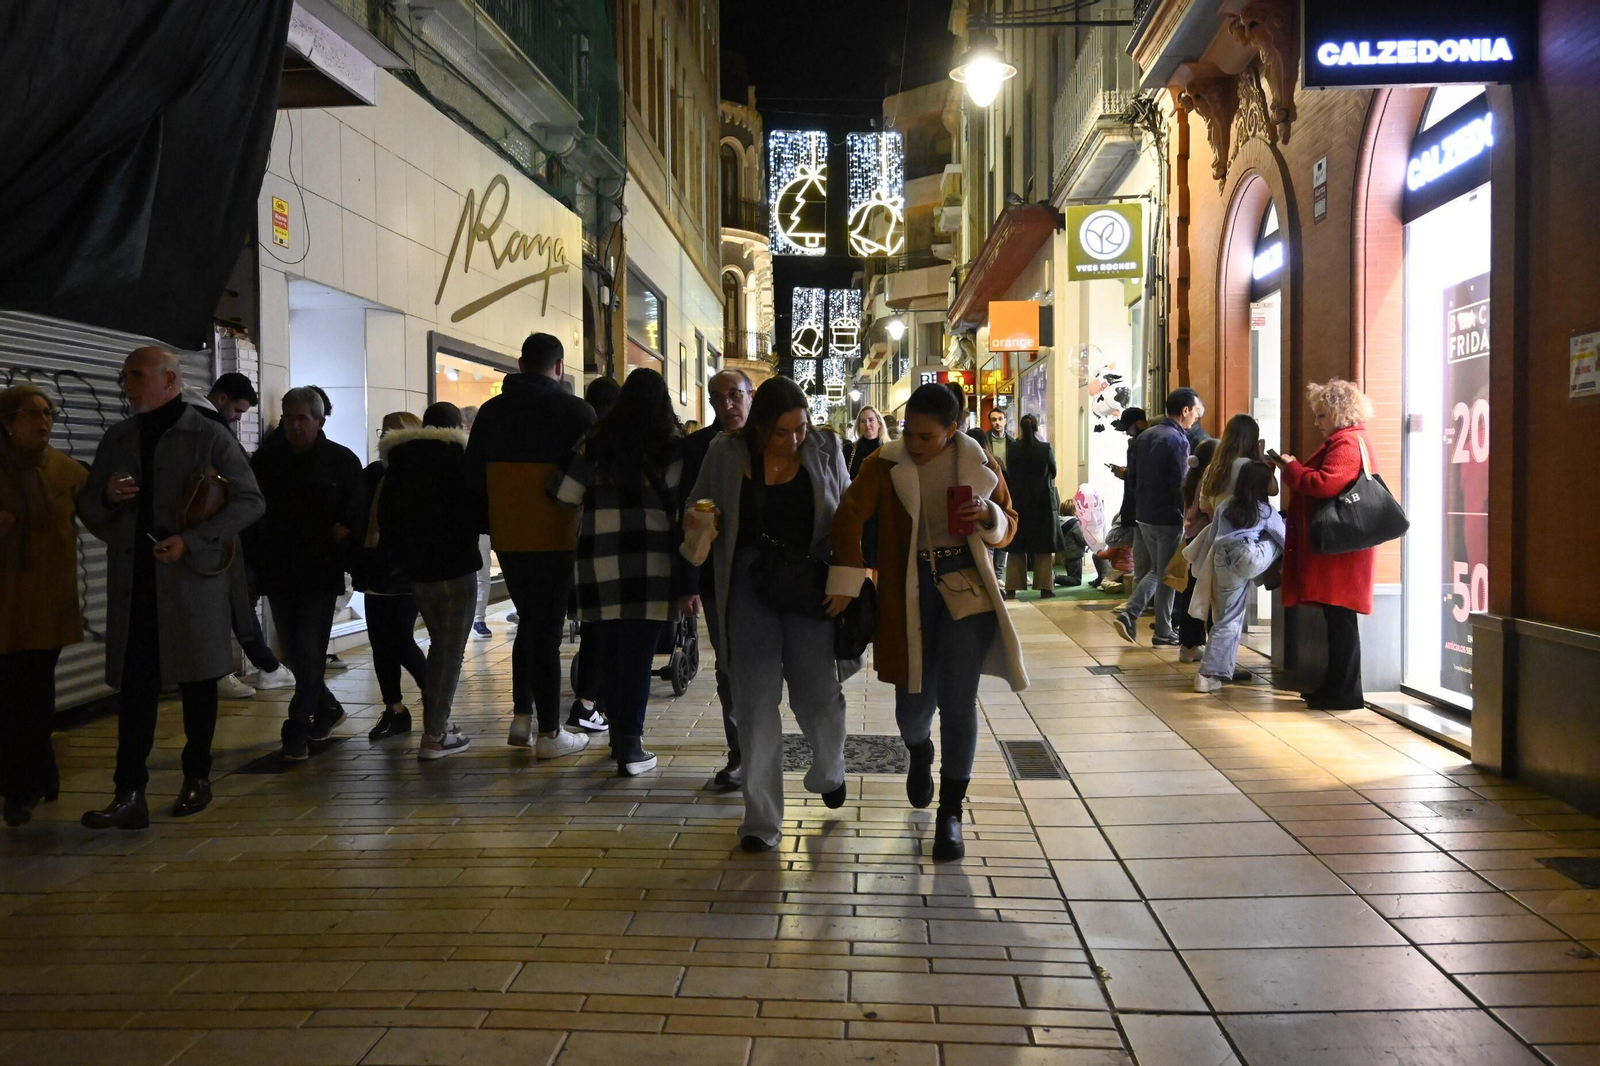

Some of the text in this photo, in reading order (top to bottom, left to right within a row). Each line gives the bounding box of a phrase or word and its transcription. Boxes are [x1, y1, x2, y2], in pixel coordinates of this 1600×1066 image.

[1317, 37, 1513, 66] CALZEDONIA
[1075, 262, 1137, 272] YVES ROCHER
[992, 338, 1034, 349] orange
[1449, 328, 1490, 359] FRIDA
[1345, 492, 1360, 505] AB
